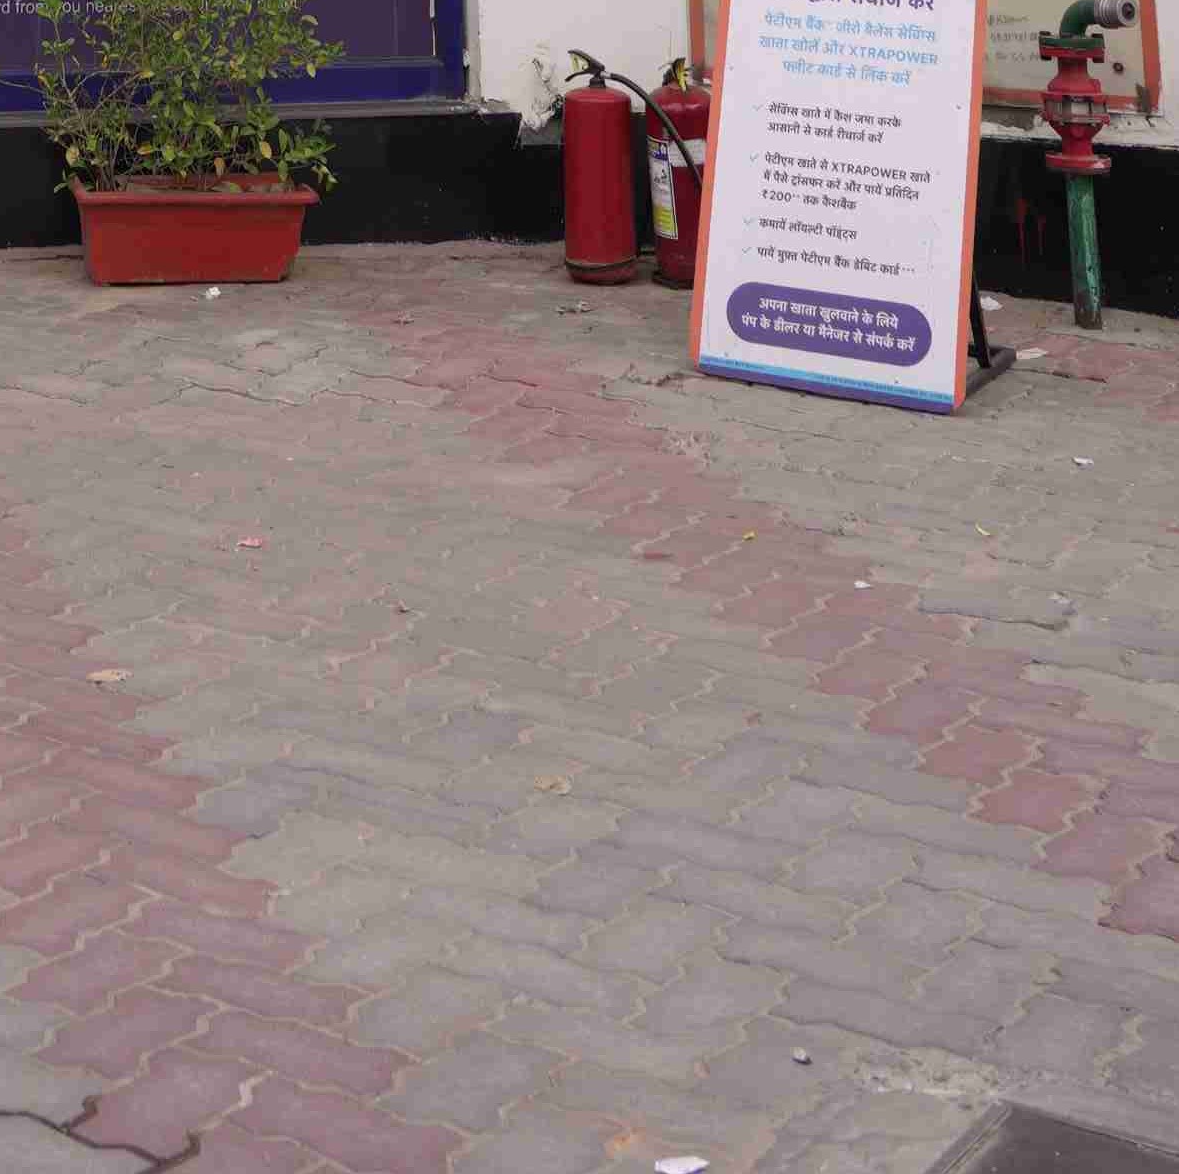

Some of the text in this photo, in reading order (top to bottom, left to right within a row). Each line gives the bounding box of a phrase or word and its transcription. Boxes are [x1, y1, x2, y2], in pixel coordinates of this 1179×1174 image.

[849, 46, 938, 64] XTRAPOWER
[801, 107, 822, 119] खाते
[854, 114, 874, 124] जमा
[767, 121, 801, 134] आसानी
[803, 124, 812, 135] से
[868, 131, 884, 144] करें
[765, 151, 794, 167] पेटीएम
[797, 156, 817, 169] खाते
[831, 162, 907, 180] XTRAPOWER
[910, 170, 931, 184] खाते
[845, 179, 862, 193] और
[803, 195, 819, 206] तक
[759, 297, 899, 329] अपना खाता खुलवाने के लिये
[741, 312, 918, 352] पंप के डीलर या मैनेजर से संपर्क करें
